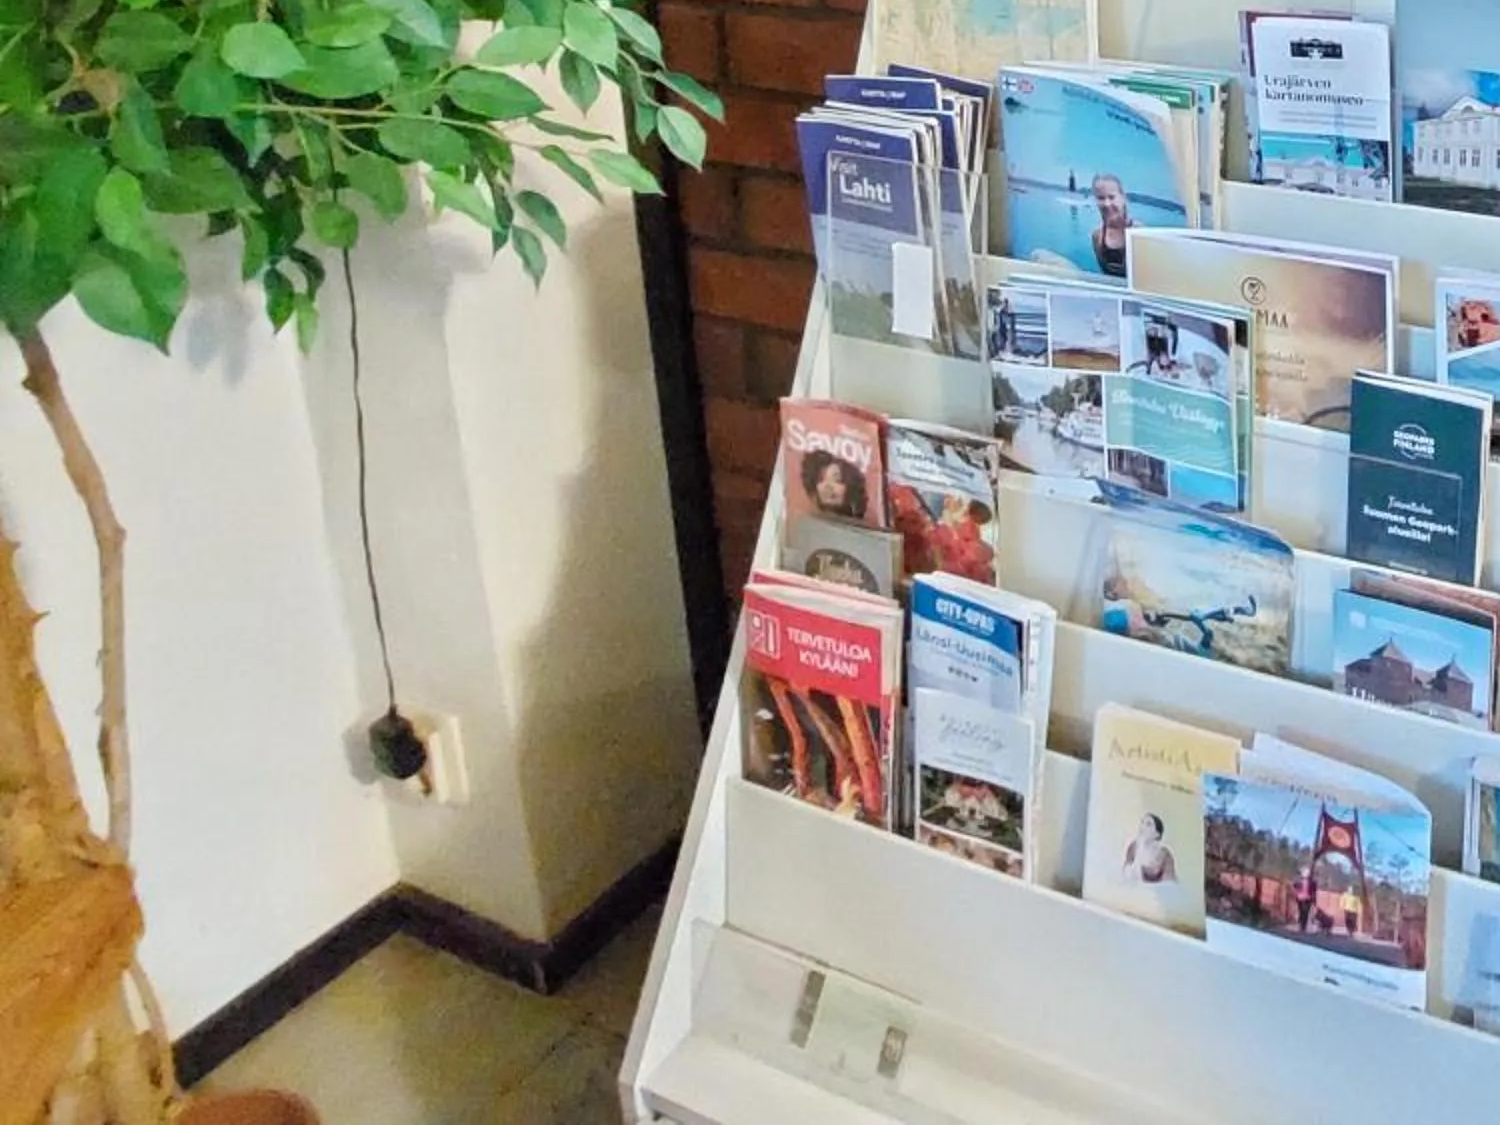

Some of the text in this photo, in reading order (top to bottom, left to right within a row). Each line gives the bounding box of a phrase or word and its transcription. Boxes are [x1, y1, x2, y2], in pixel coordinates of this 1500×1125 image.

[839, 175, 892, 204] Lahti
[787, 419, 873, 473] Savoy
[786, 626, 872, 663] TERVETULOA
